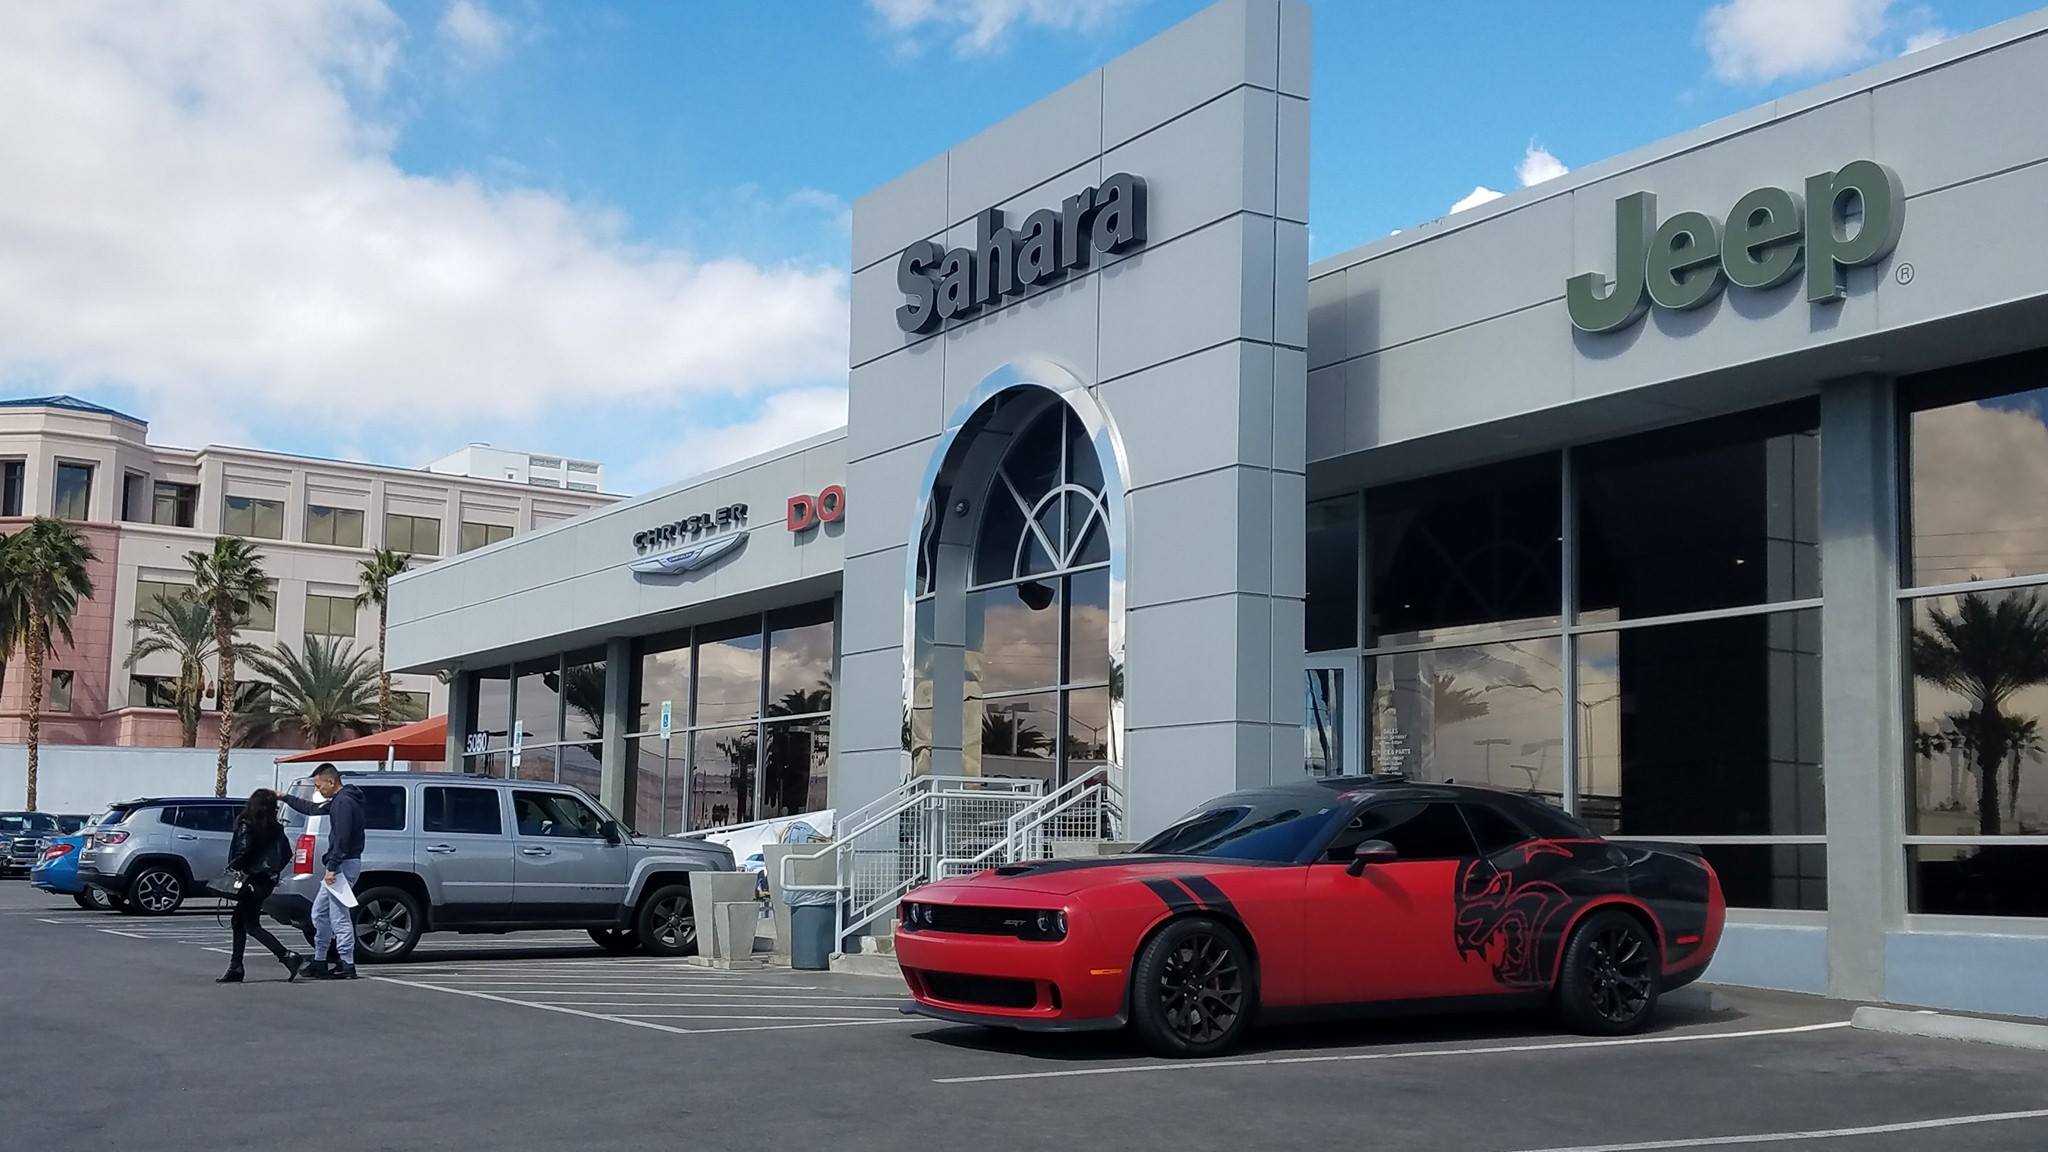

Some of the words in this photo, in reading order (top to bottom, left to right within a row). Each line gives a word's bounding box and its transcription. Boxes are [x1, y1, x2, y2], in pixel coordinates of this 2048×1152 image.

[896, 172, 1147, 334] Sahara
[1565, 159, 1906, 333] Jeep
[633, 502, 749, 549] CHRYSLER
